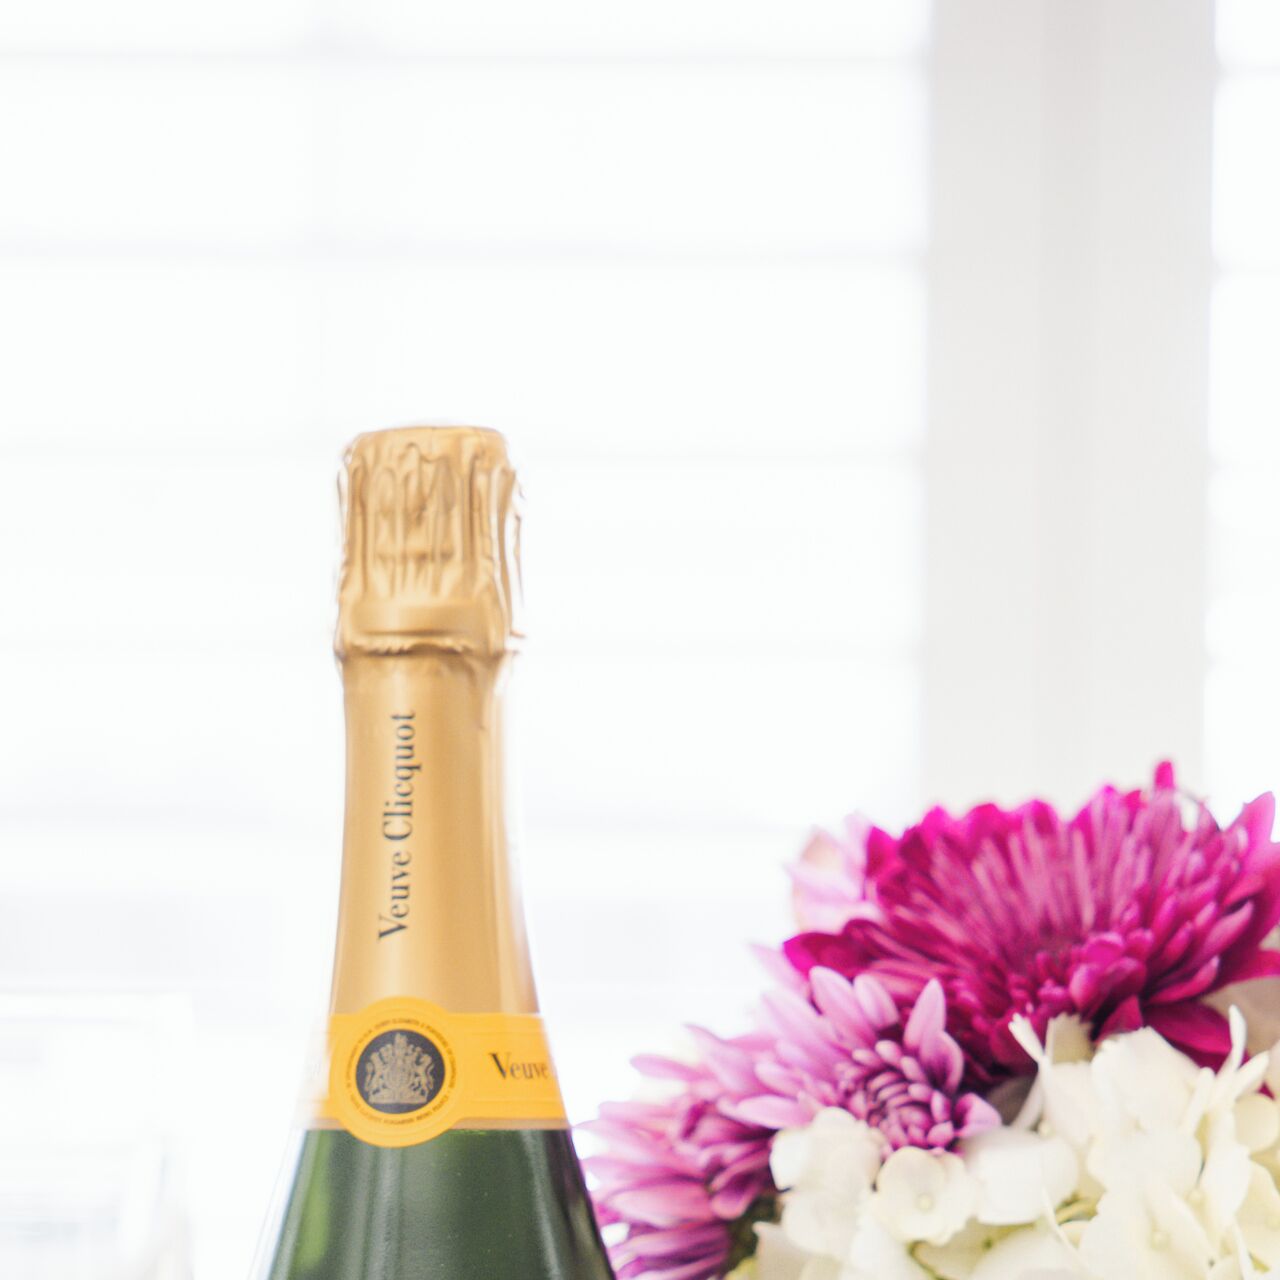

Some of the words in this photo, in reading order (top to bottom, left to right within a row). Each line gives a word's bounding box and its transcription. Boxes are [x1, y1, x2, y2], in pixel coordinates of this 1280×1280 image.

[382, 710, 422, 841] Clicquot
[377, 850, 412, 941] Veuve
[489, 1052, 548, 1080] Veuve
